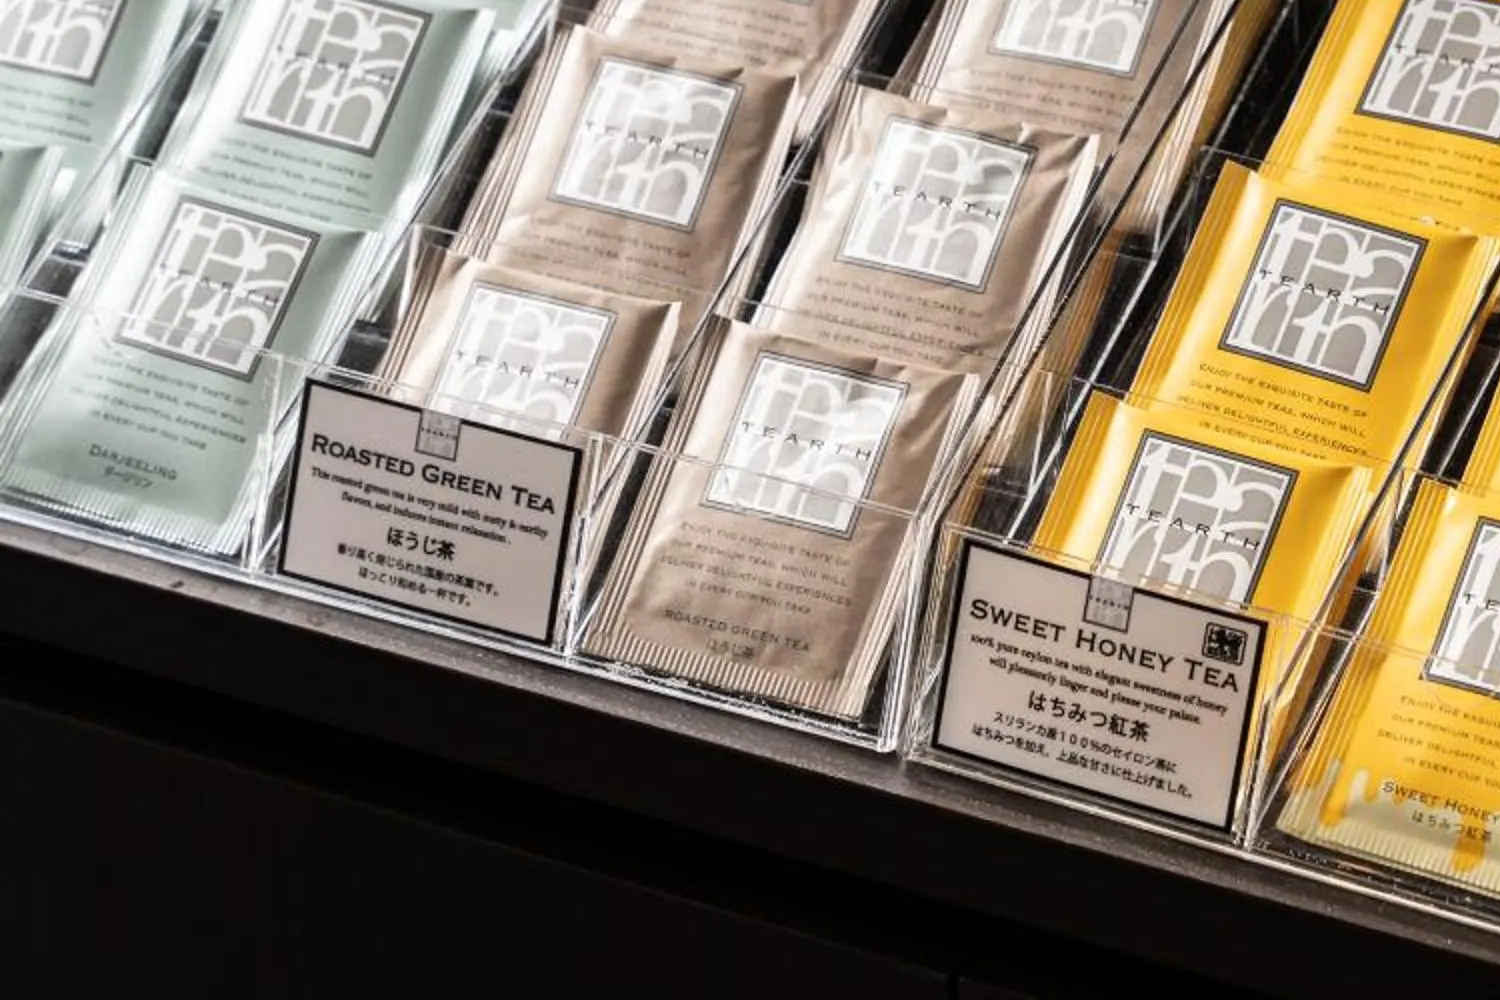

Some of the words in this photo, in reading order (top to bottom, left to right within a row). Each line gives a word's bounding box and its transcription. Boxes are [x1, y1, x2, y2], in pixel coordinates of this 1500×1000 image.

[1257, 269, 1391, 316] TEARTH
[742, 422, 871, 459] TEARTH
[89, 444, 178, 481] DARJEELING
[310, 432, 415, 478] ROASTED
[420, 462, 502, 501] GREEN
[509, 484, 557, 515] TEA
[374, 500, 392, 513] and
[386, 525, 457, 562] ほうじ茶
[1127, 503, 1260, 550] TEARTH
[665, 608, 728, 632] ROASTED
[731, 624, 779, 644] GREEN
[969, 597, 1066, 643] SWEET
[1074, 628, 1175, 674] HONEY
[1181, 657, 1241, 693] TEA
[1071, 661, 1093, 676] with
[1089, 684, 1108, 699] and
[1027, 689, 1151, 744] はちみつ紅茶
[1382, 781, 1441, 806] SWEET
[1443, 798, 1500, 825] HONEY
